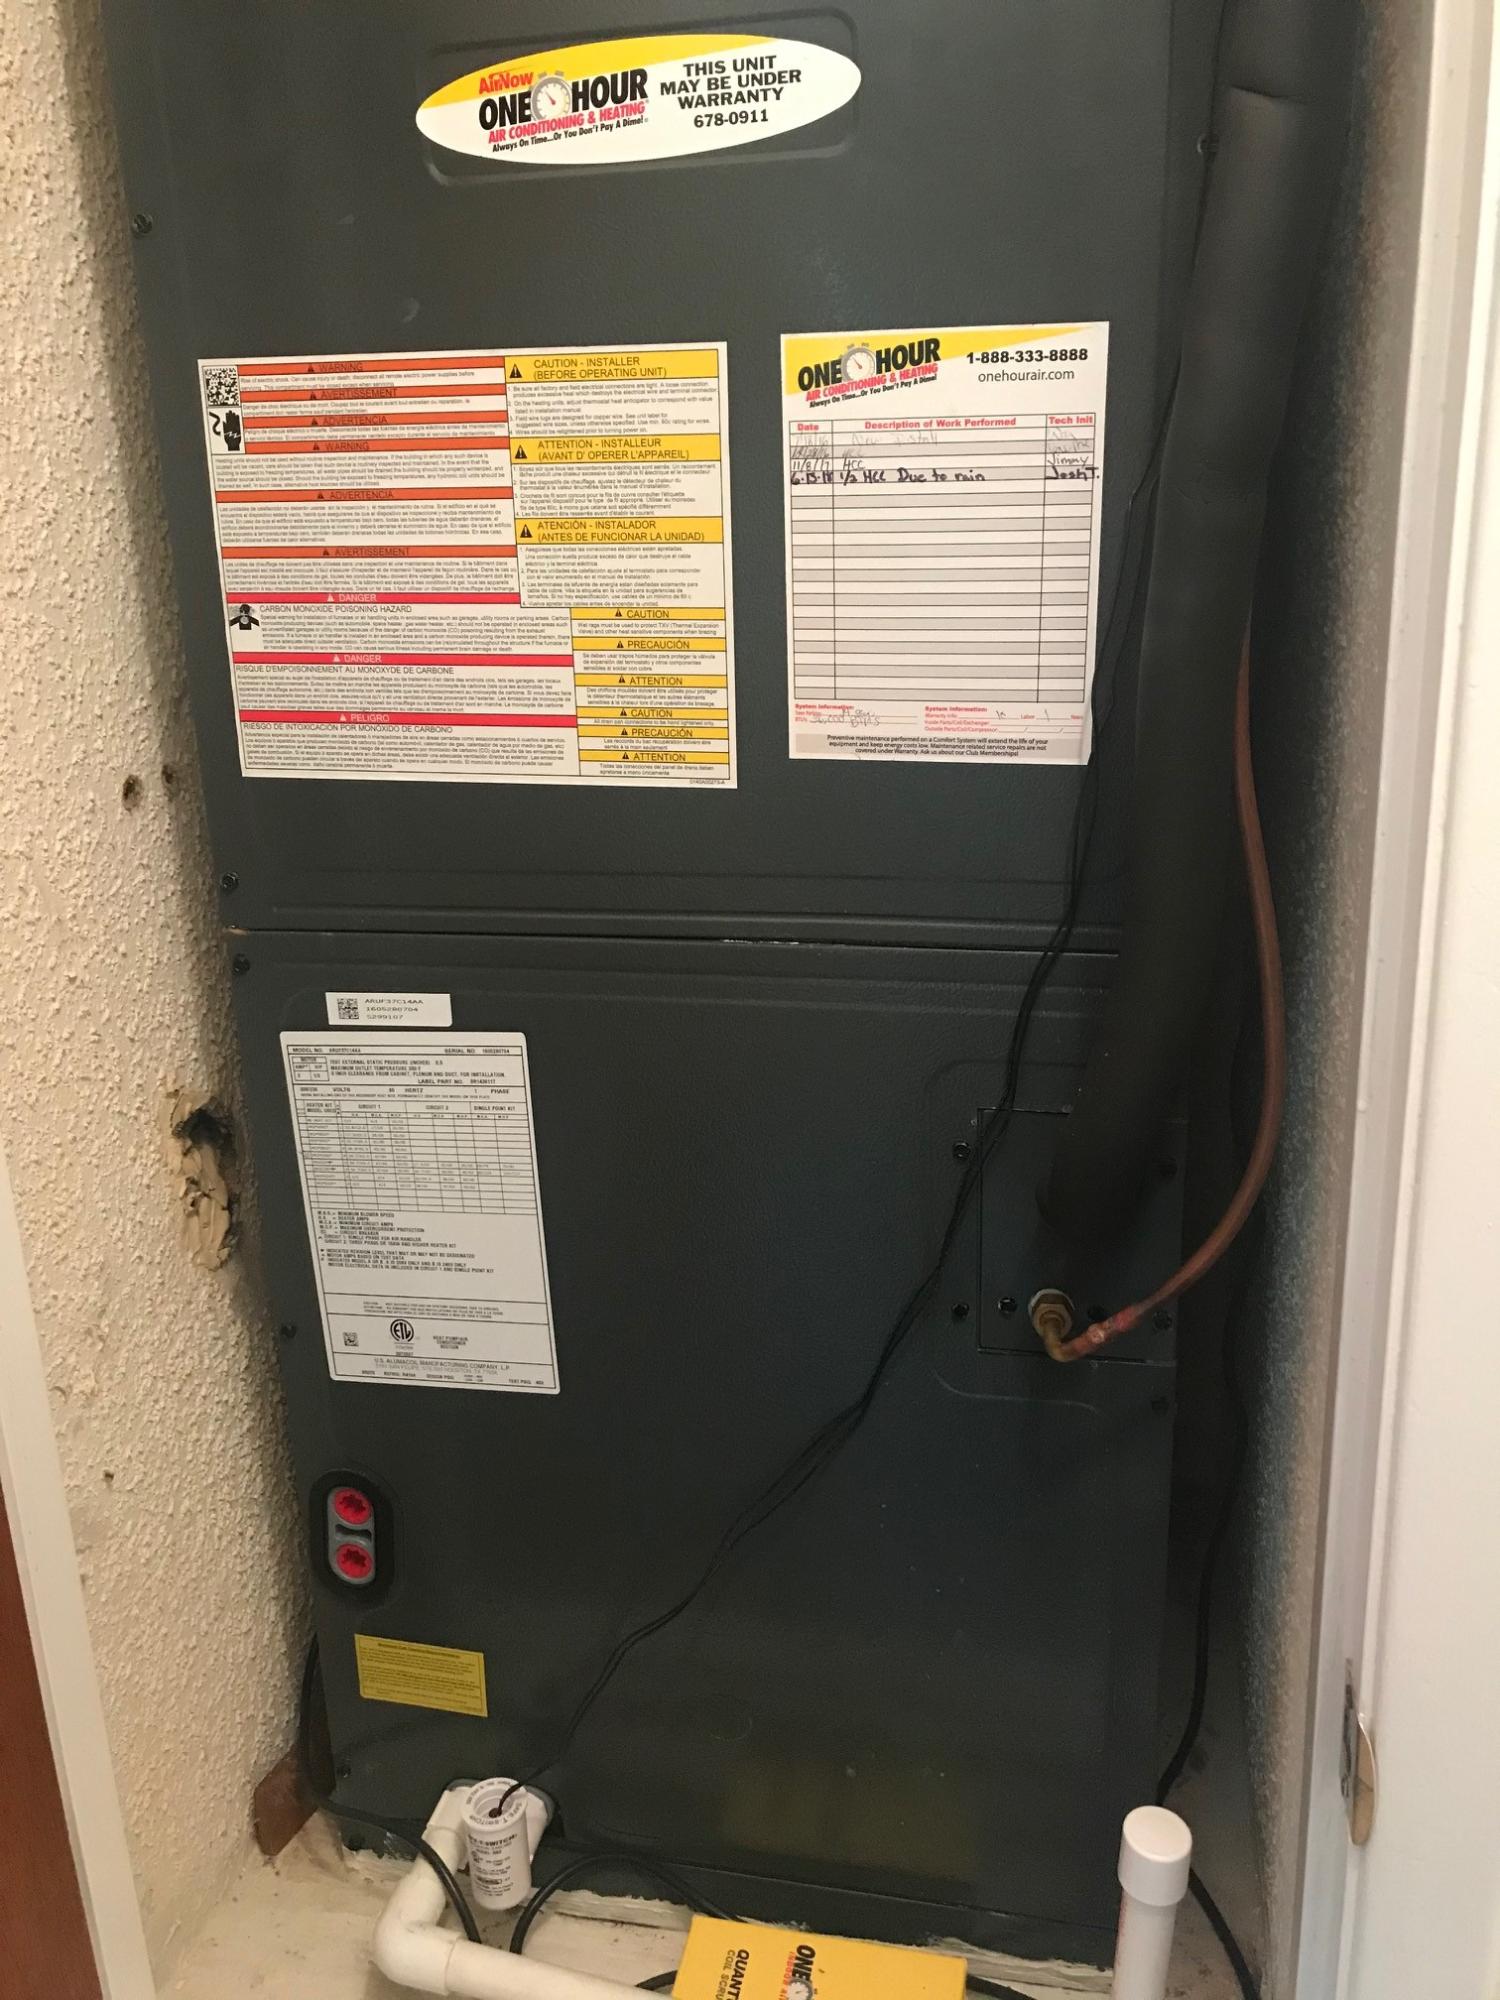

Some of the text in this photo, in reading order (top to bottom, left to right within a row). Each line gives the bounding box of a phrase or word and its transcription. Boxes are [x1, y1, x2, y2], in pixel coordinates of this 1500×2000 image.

[683, 55, 776, 77] THIS UNIT
[479, 71, 534, 95] AirNow
[661, 69, 801, 96] MAY BE UNDER
[479, 69, 648, 131] ONE HOUR
[678, 87, 783, 110] WARRANTY
[488, 100, 647, 144] AIR CONDITIONING & HEATING
[694, 109, 768, 128] 678-0911
[493, 115, 646, 154] Always On Time...Or You Don't Pay A Dime!
[967, 349, 1088, 364] 1-888-333-8888
[319, 362, 363, 372] WARNING
[534, 357, 640, 368] CAUTION INSTALLER
[798, 338, 941, 391] ONE HOUR
[534, 367, 667, 380] (BEFORE OPERATING UNIT)
[978, 369, 1074, 382] onehourair.com
[806, 363, 938, 402] AIR CONDITIONING & HEATING
[321, 388, 397, 399] AVERTISSEMENT
[323, 415, 387, 425] ADVERTENCIA
[865, 417, 1016, 430] Description of Work Performed
[1048, 416, 1093, 424] Tech Init
[325, 442, 370, 451] WARNING
[538, 439, 661, 449] ATTENTION INSTALLEUR
[539, 450, 689, 461] (AVANT D' OPERER L'APPAREIL)
[897, 467, 927, 482] Due
[932, 468, 948, 482] to
[954, 470, 986, 482] rain
[329, 490, 394, 500] ADVERTENCIA
[537, 521, 656, 530] ATENCIÓN INSTALADOR
[538, 532, 704, 542] (ANTES DE FUNCIONAR LA UNIDAD)
[335, 547, 410, 556] AVERTISSEMENT
[339, 594, 376, 602] DANGER
[627, 610, 669, 619] CAUTION
[628, 640, 690, 649] PRECAUCIÓN
[344, 655, 382, 663] DANGER
[235, 665, 264, 673] RISQUE
[266, 665, 343, 673] D'EMPOISONNEMENT
[358, 666, 401, 674] MONOXYDE
[630, 677, 683, 686] ATTENTION
[351, 714, 389, 722] PELIGRO
[631, 709, 672, 717] CAUTION
[243, 722, 272, 731] RIESGO
[286, 723, 338, 731] INTOXICACIÓN
[358, 724, 400, 732] MONÓXIDO
[414, 725, 453, 733] CARBONO
[632, 727, 693, 737] PRECAUCIÓN
[633, 753, 686, 762] ATTENTION
[723, 1949, 735, 1970] COIL
[792, 1945, 815, 1982] ONE
[727, 1949, 750, 2000] QUANT
